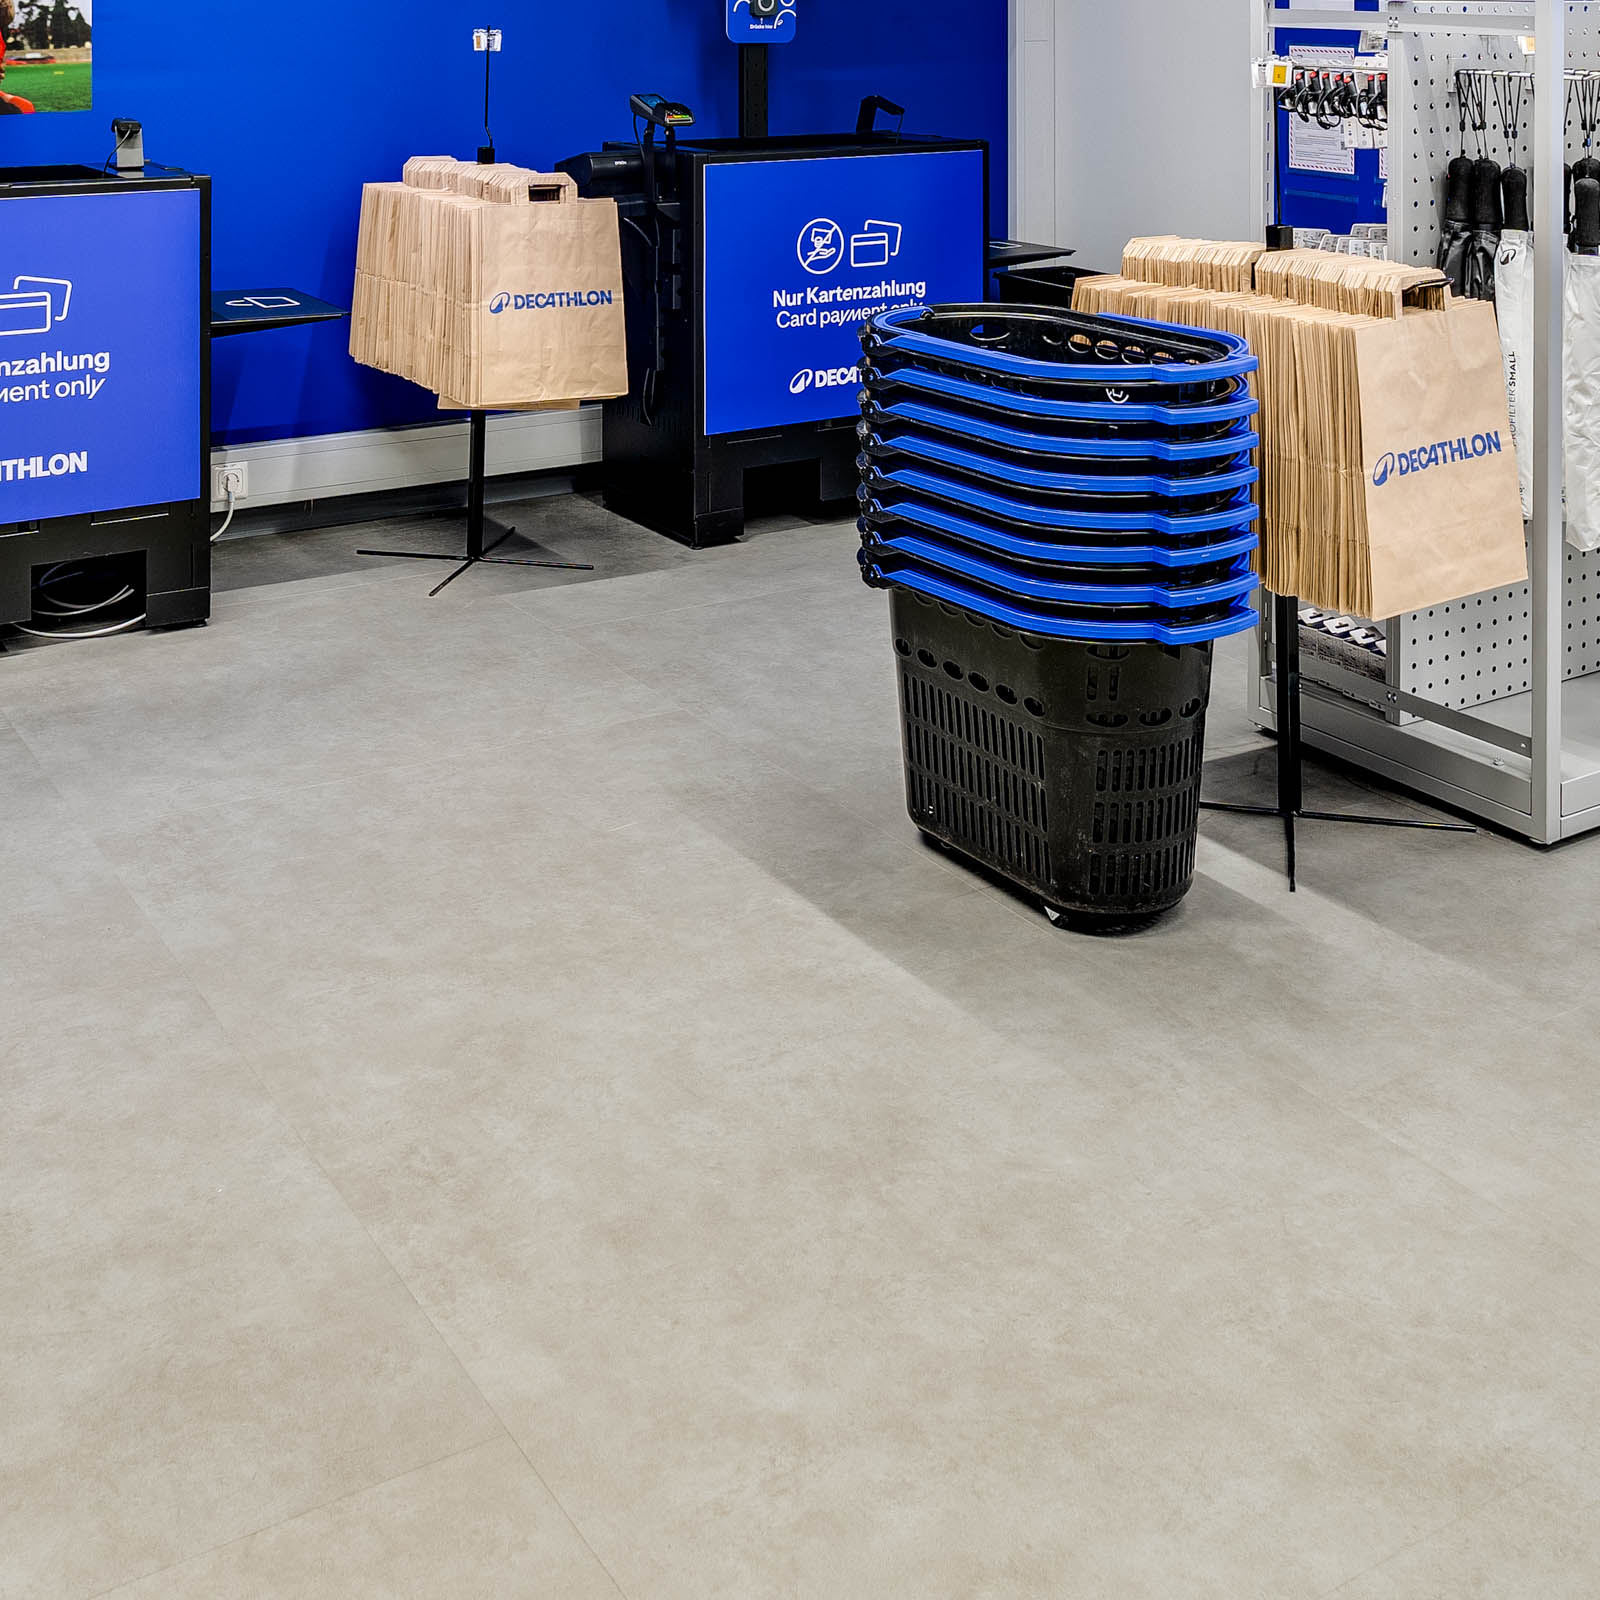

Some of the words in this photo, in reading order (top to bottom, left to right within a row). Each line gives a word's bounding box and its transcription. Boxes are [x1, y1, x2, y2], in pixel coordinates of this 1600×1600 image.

[513, 289, 613, 311] DECATHLON
[773, 289, 804, 308] Nur
[807, 279, 927, 305] Kartenzahlung
[776, 309, 816, 329] Card
[1508, 351, 1516, 387] SMALL
[55, 375, 106, 399] only
[1398, 430, 1503, 476] DECATHLON
